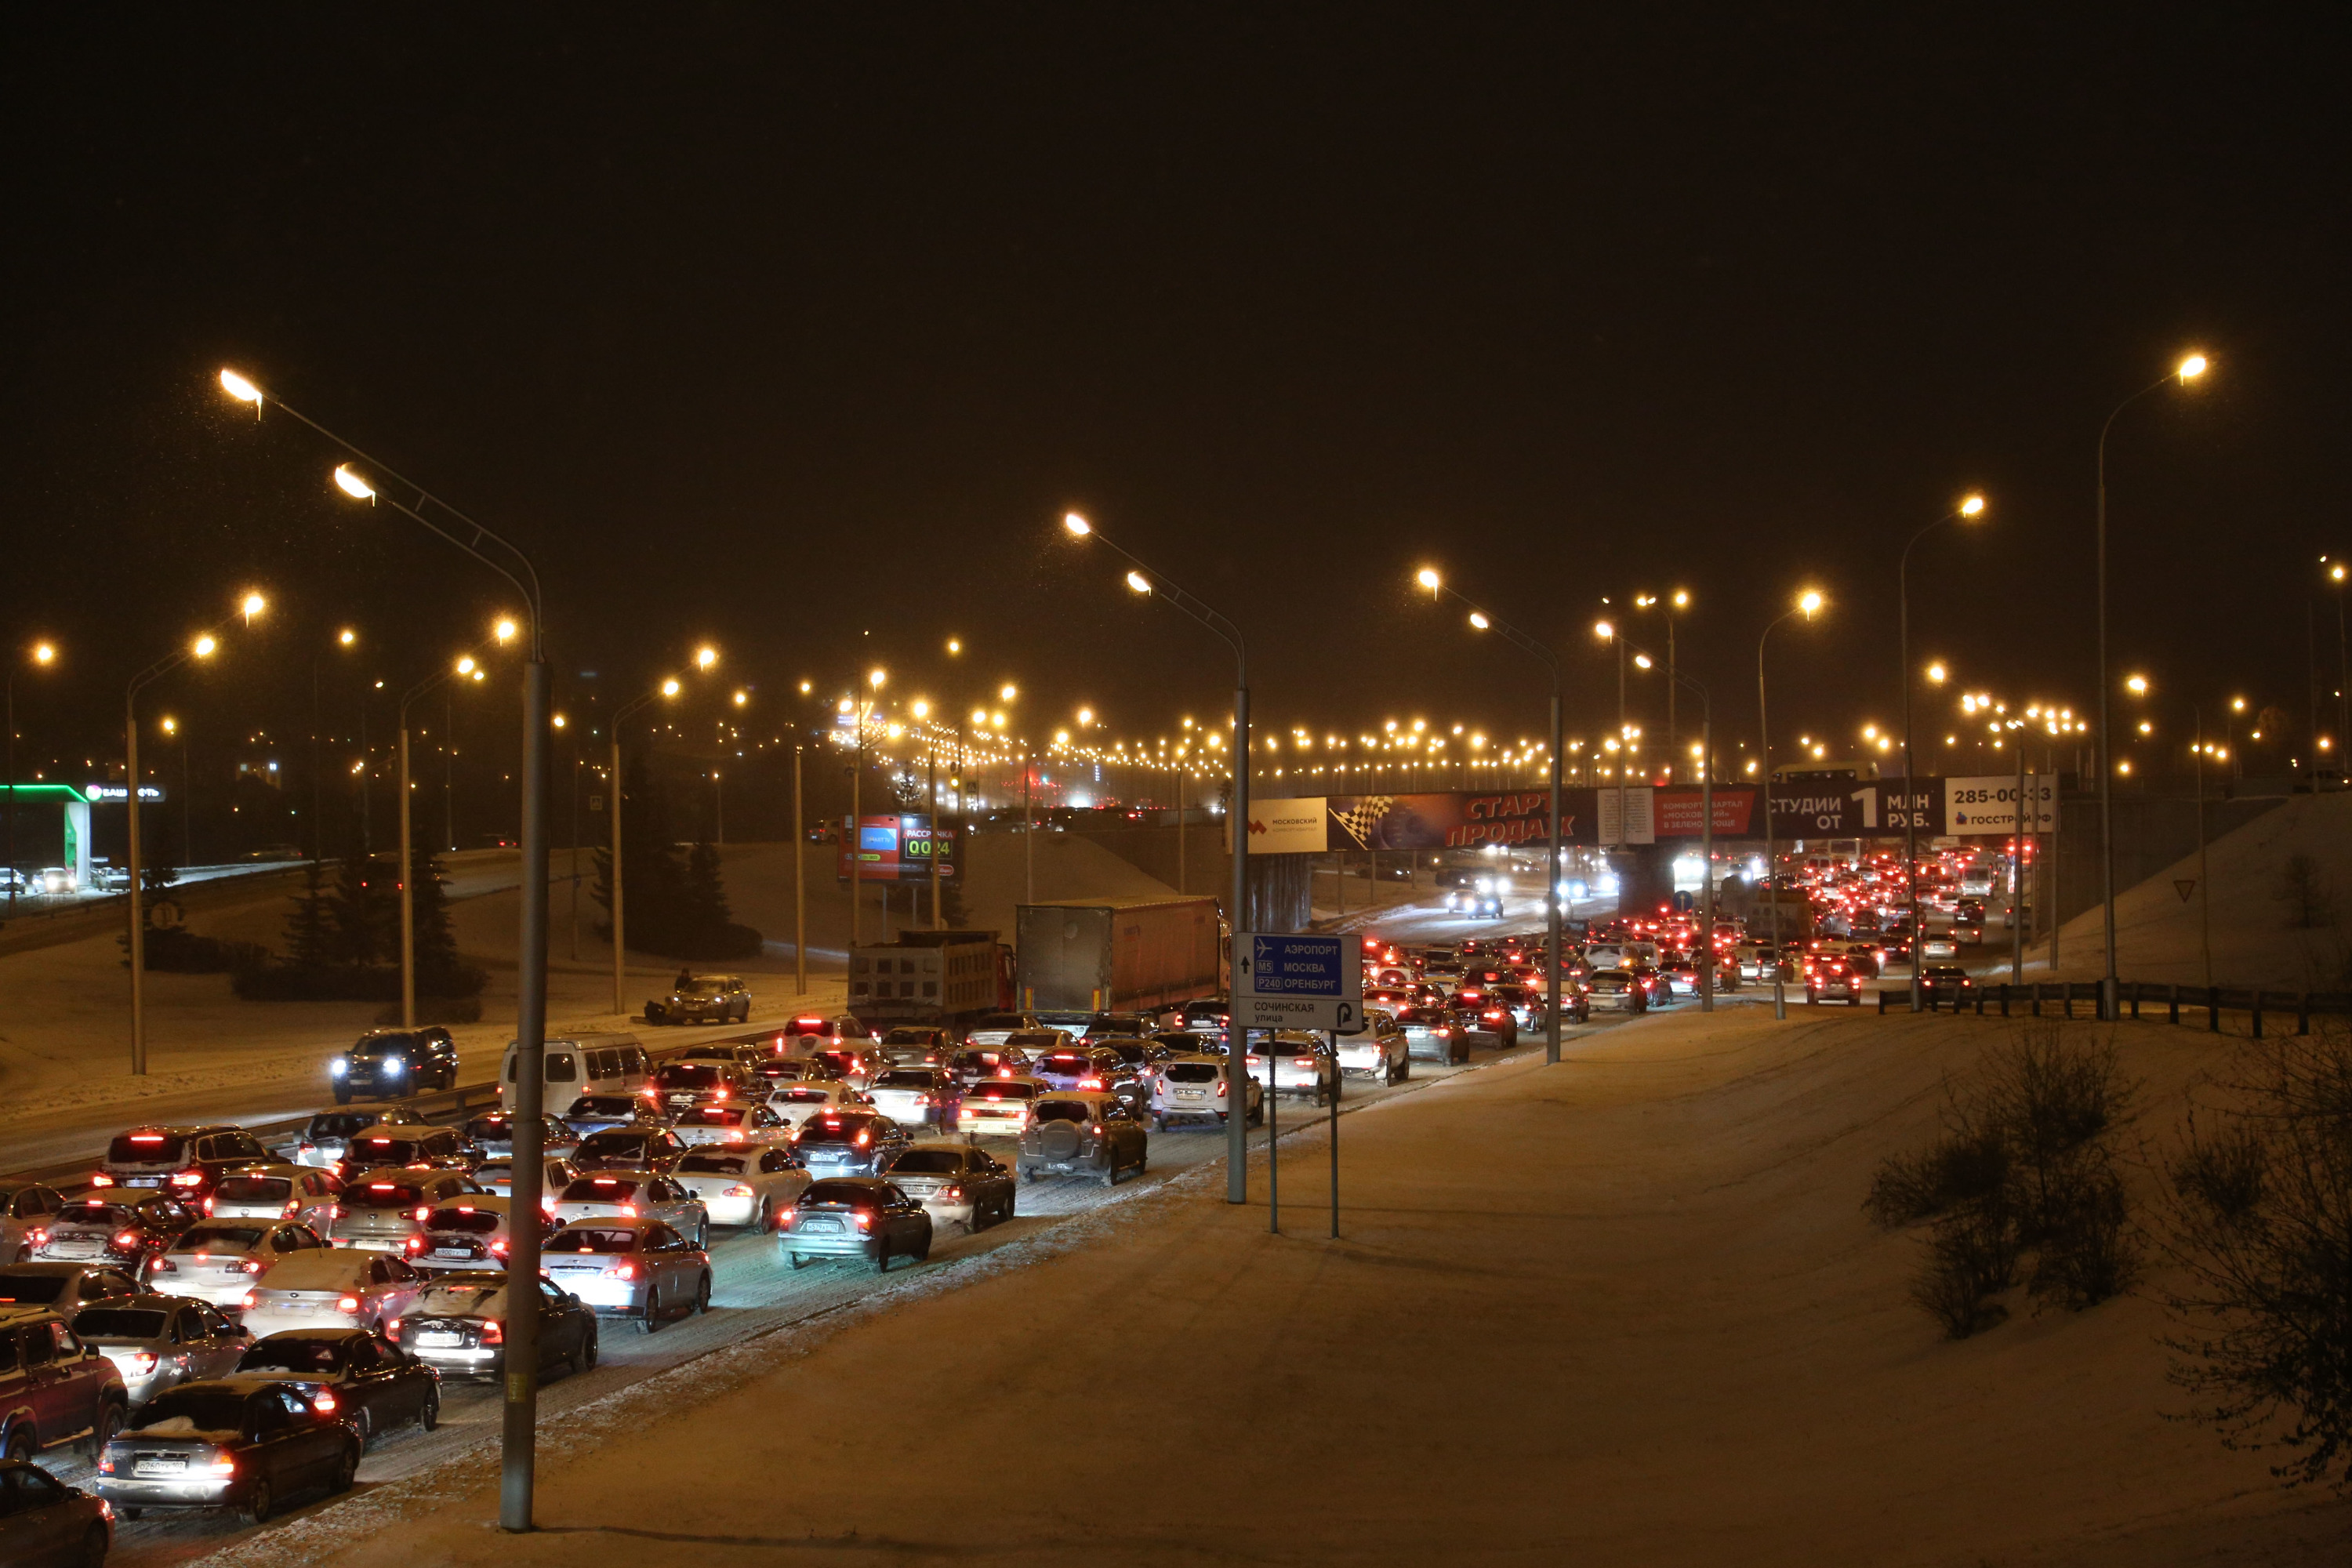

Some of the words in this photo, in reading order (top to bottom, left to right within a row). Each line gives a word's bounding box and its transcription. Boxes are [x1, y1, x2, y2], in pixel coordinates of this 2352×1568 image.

[103, 788, 160, 797] БАШФТЬ
[1769, 797, 1841, 815] СТУДИИ
[1850, 786, 1877, 828] 1
[1887, 794, 1929, 809] МЛН
[1664, 809, 1730, 819] «МОСКОВИЙ»
[1817, 815, 1842, 829] ОТ
[1888, 812, 1930, 828] РУБ.
[906, 829, 953, 838] РАССРЧКА
[1445, 815, 1575, 847] ПРОДАЖ
[1284, 945, 1338, 955] АЭРОПОРТ
[1283, 963, 1326, 973] МОСКВА
[1258, 978, 1280, 988] Р240
[1284, 978, 1336, 989] ОРЕНБУРГ
[1254, 1002, 1315, 1013] СОЧИНСКАЯ
[1255, 1014, 1283, 1023] улица
